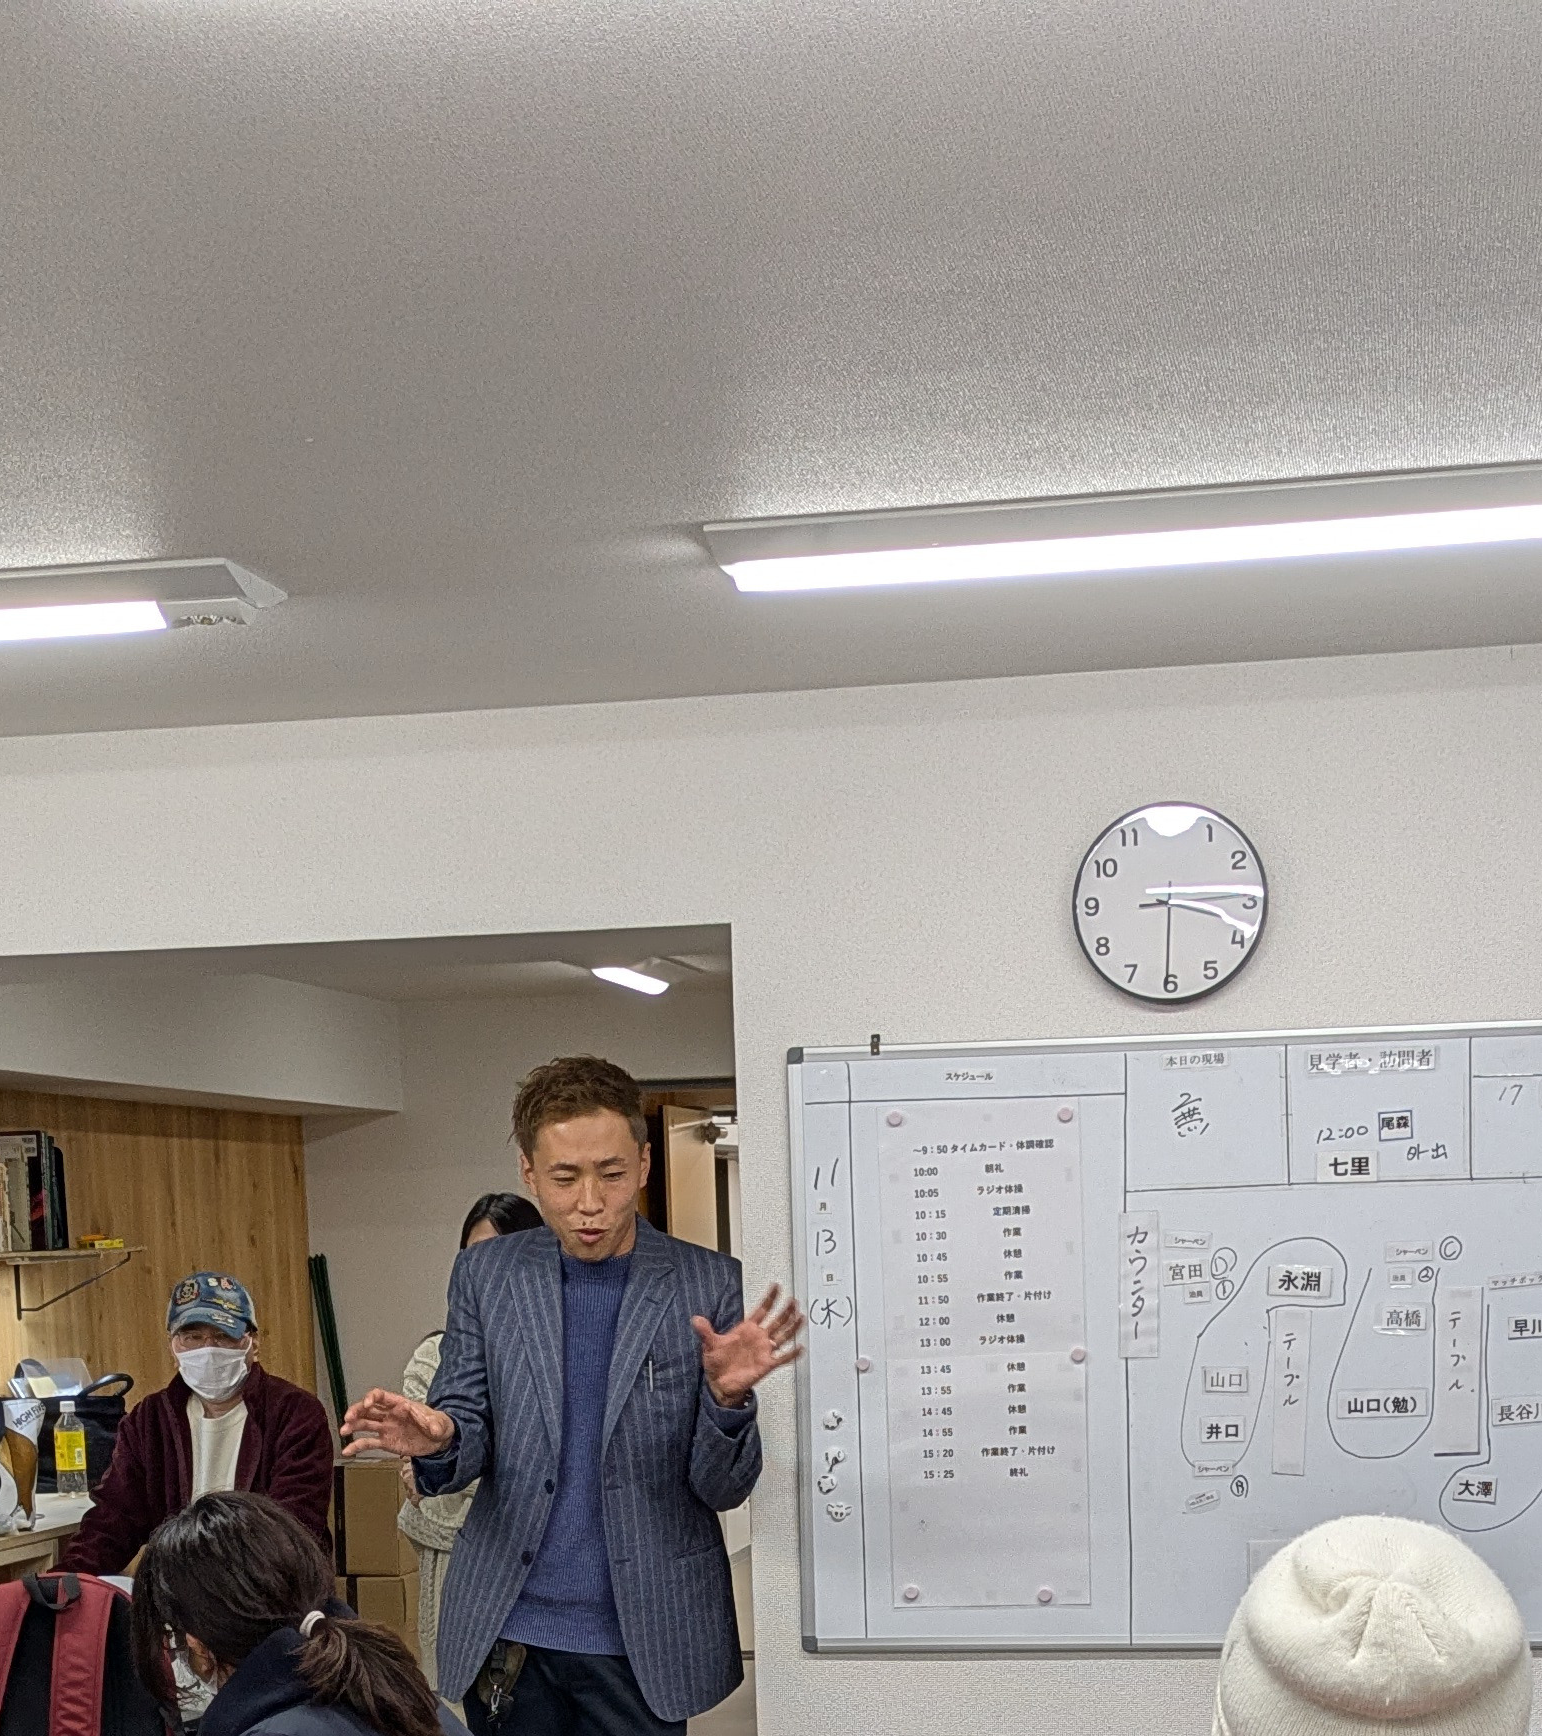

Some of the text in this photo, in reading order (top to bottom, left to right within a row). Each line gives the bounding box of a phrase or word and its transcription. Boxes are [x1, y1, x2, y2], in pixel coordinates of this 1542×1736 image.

[1120, 827, 1139, 847] 11
[1206, 823, 1214, 842] 1
[1094, 858, 1118, 878] 10
[1230, 850, 1247, 870] 2
[1084, 897, 1100, 916] 9
[1242, 893, 1258, 910] 3
[1095, 936, 1110, 956] 8
[1231, 929, 1245, 949] 4
[1124, 964, 1138, 983] 7
[1203, 960, 1219, 980] 5
[1163, 973, 1179, 993] 6
[1165, 1052, 1226, 1068] 本日の現場
[945, 1071, 994, 1082] スケジュール
[1497, 1083, 1524, 1107] 17
[1316, 1125, 1369, 1145] 12:00
[1406, 1142, 1449, 1161] 外出
[913, 1166, 939, 1178] 10:00
[1328, 1156, 1371, 1177] 七里
[914, 1188, 940, 1199] 10:05
[815, 1228, 837, 1257] 13
[1168, 1263, 1203, 1281] 宮田
[1126, 1225, 1150, 1341] カウンター
[1210, 1372, 1243, 1388] 山口
[1206, 1423, 1240, 1439] 井口
